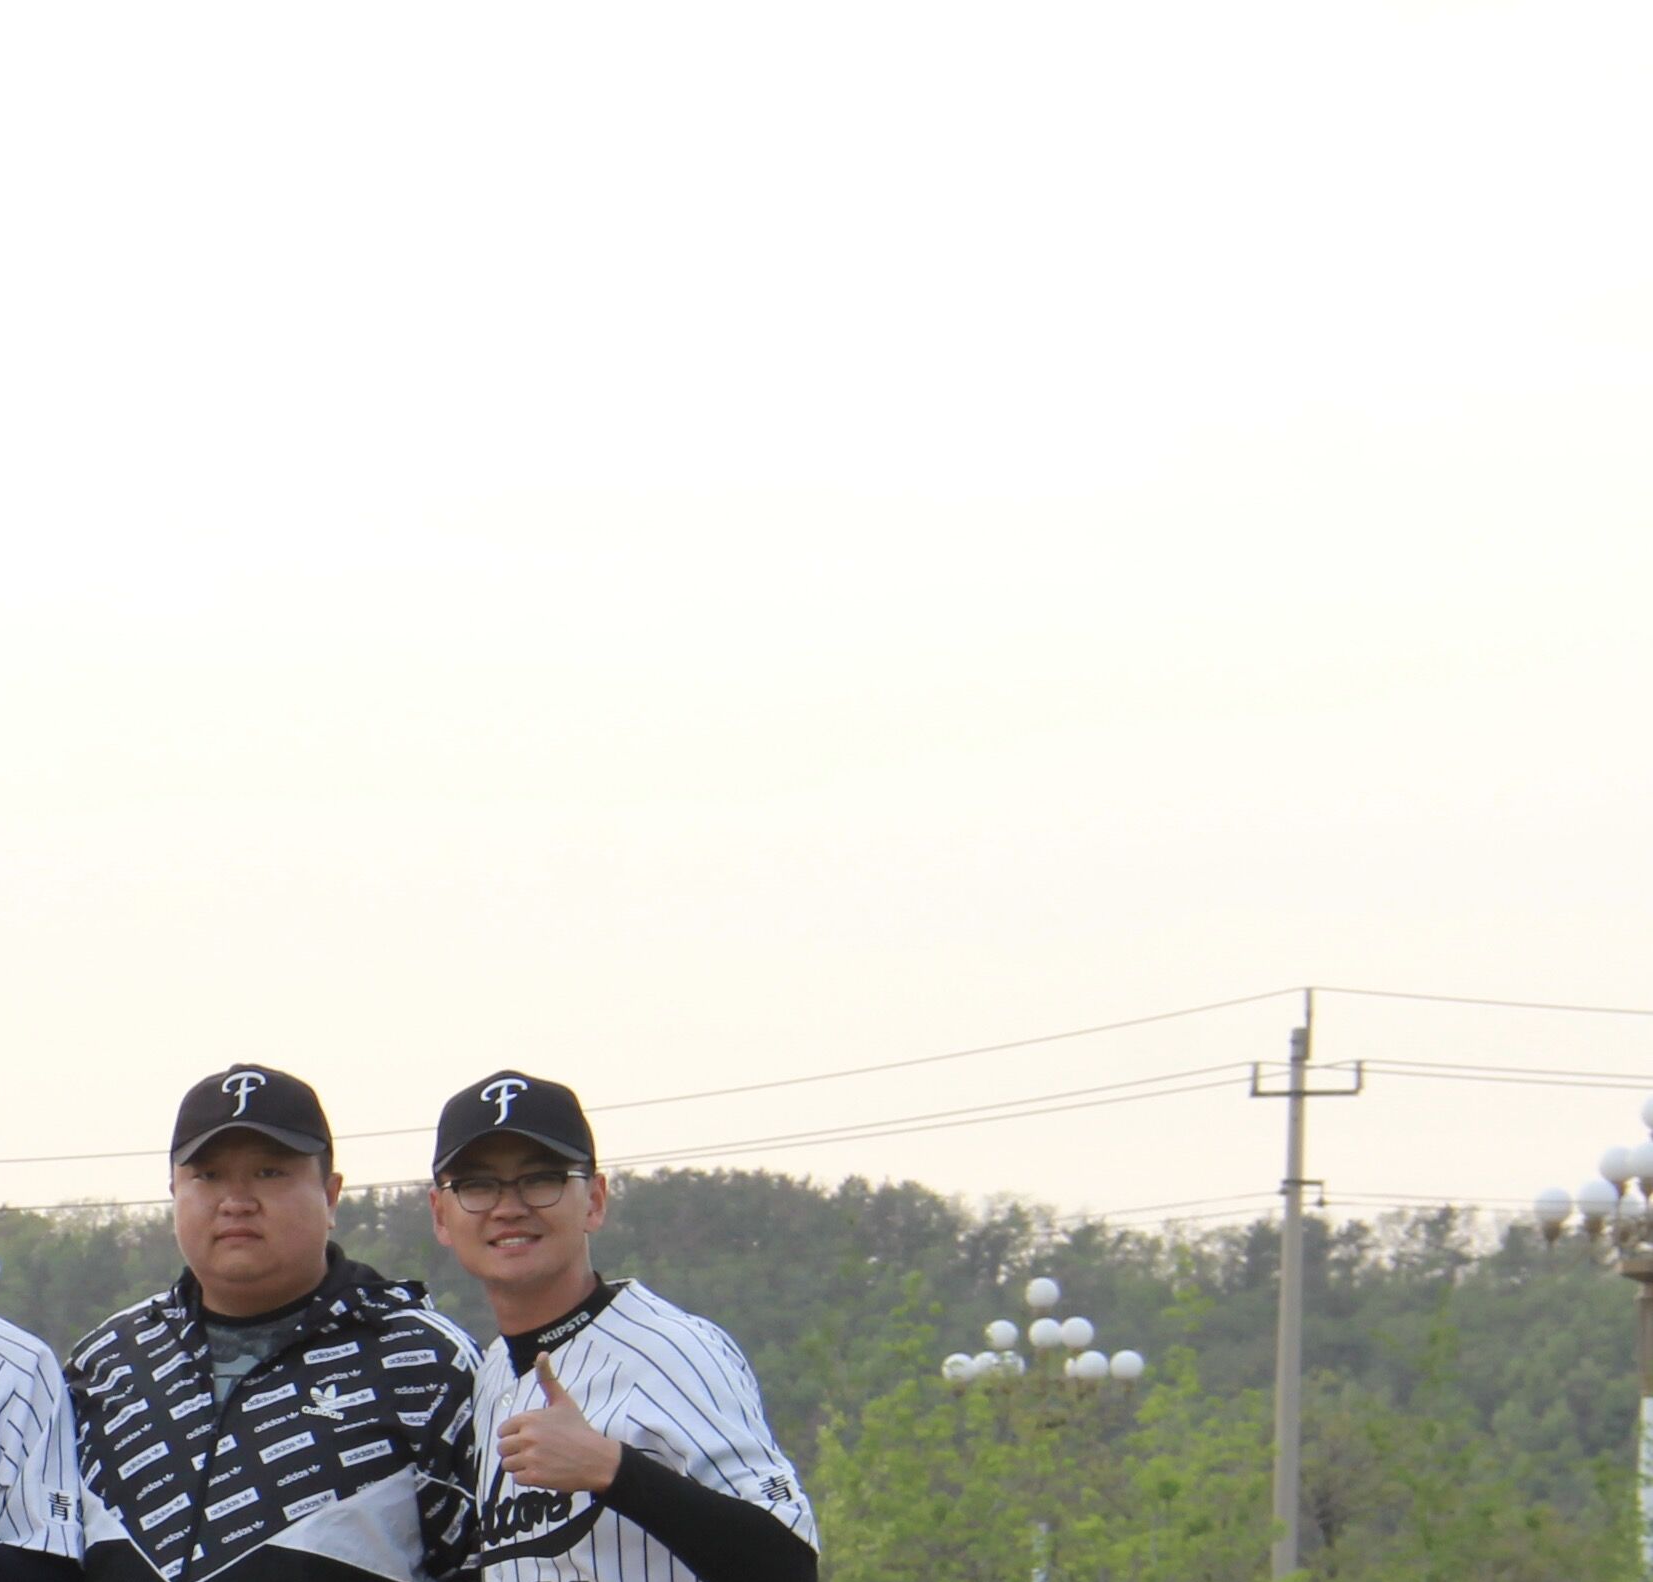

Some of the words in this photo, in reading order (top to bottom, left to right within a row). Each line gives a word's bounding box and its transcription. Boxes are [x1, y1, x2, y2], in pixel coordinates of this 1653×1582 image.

[302, 1405, 345, 1420] adidas
[277, 1468, 310, 1487] adidas
[221, 1525, 254, 1544] adidas
